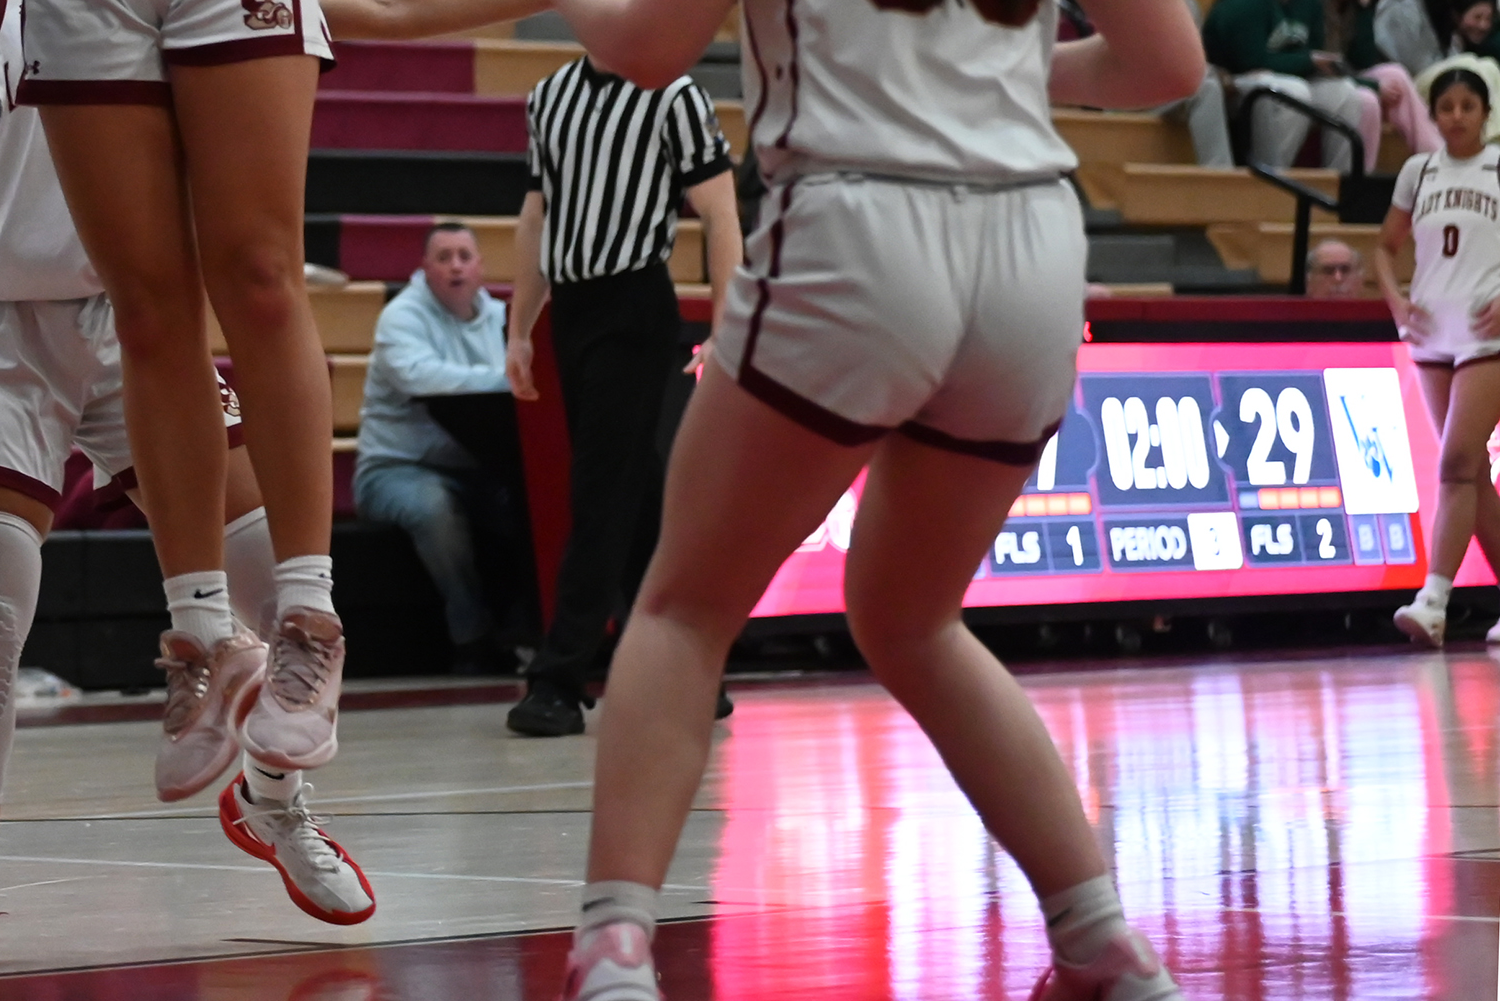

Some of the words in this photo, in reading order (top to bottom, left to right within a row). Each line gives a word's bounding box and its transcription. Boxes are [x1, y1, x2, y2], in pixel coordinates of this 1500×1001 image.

[1442, 223, 1460, 258] 0
[1100, 396, 1211, 492] 02:00
[1238, 386, 1315, 486] 29
[994, 531, 1042, 565] FLS
[1065, 525, 1085, 567] 1
[1109, 525, 1188, 562] PERIOD
[1250, 523, 1295, 556] FLS
[1315, 518, 1337, 560] 2
